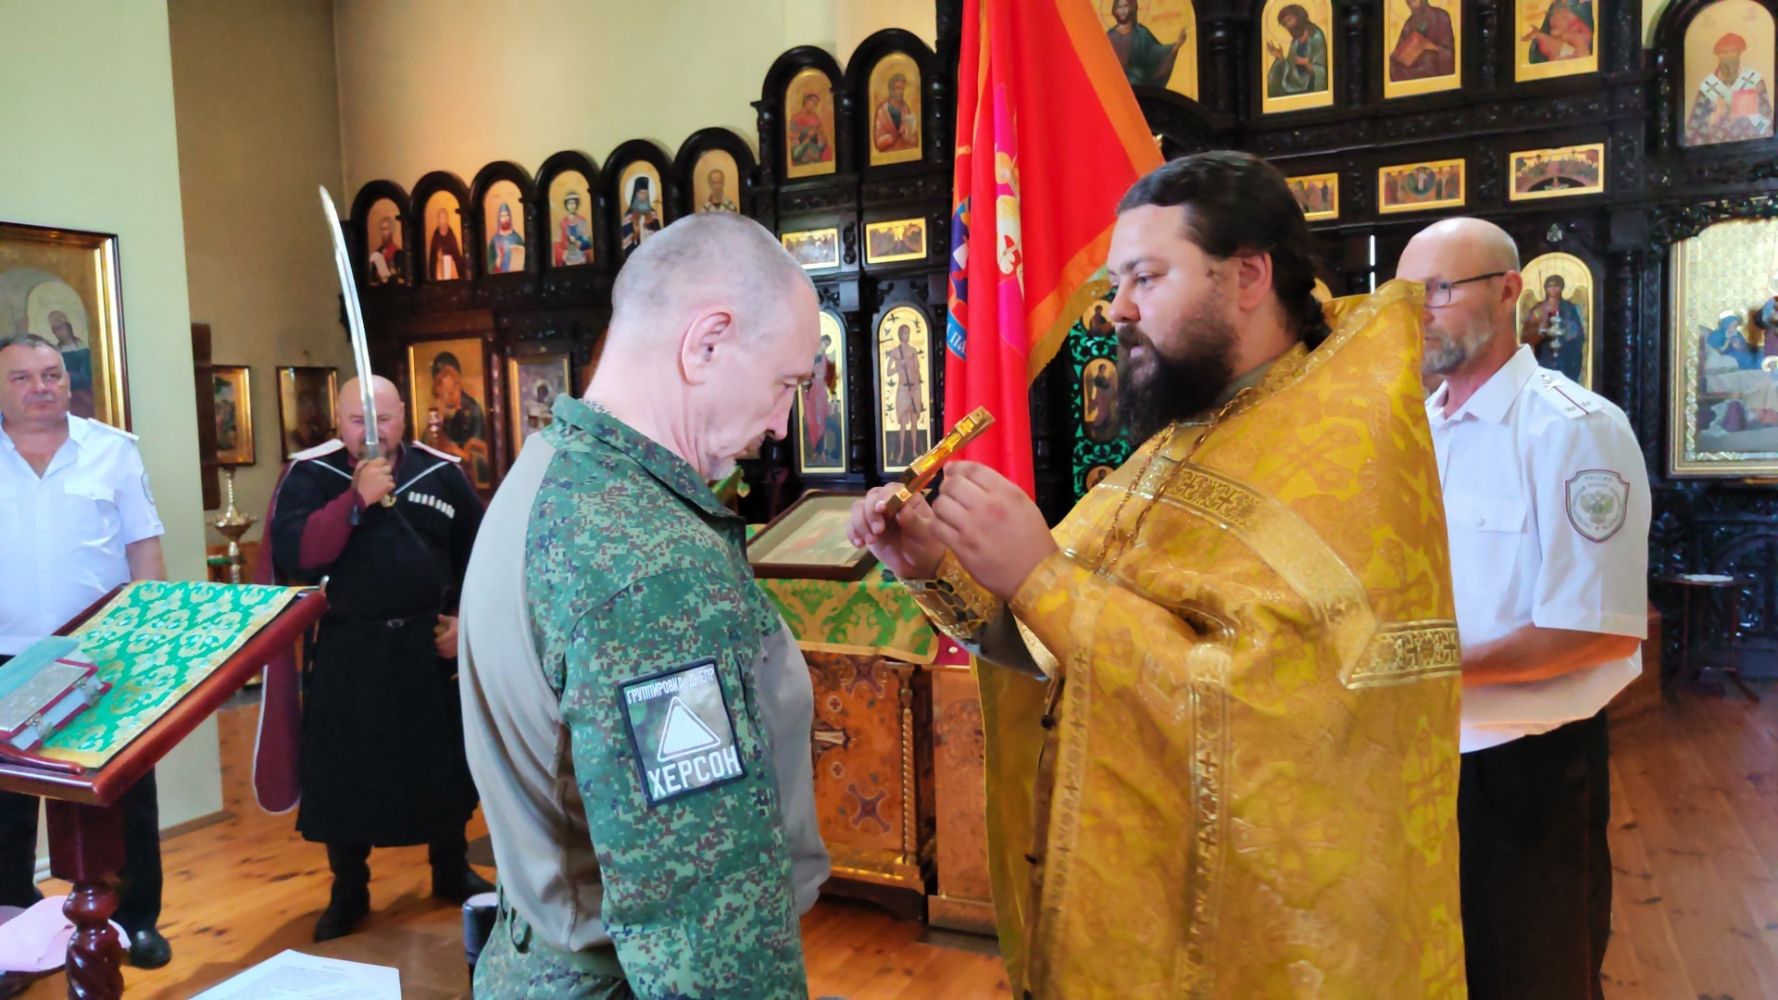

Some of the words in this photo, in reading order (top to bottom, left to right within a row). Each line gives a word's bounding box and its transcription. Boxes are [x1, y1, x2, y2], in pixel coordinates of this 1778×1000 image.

[626, 676, 685, 704] ГРУППИРОВКА
[688, 667, 715, 688] ДНЕПР
[648, 745, 741, 798] ХЕРСОН
